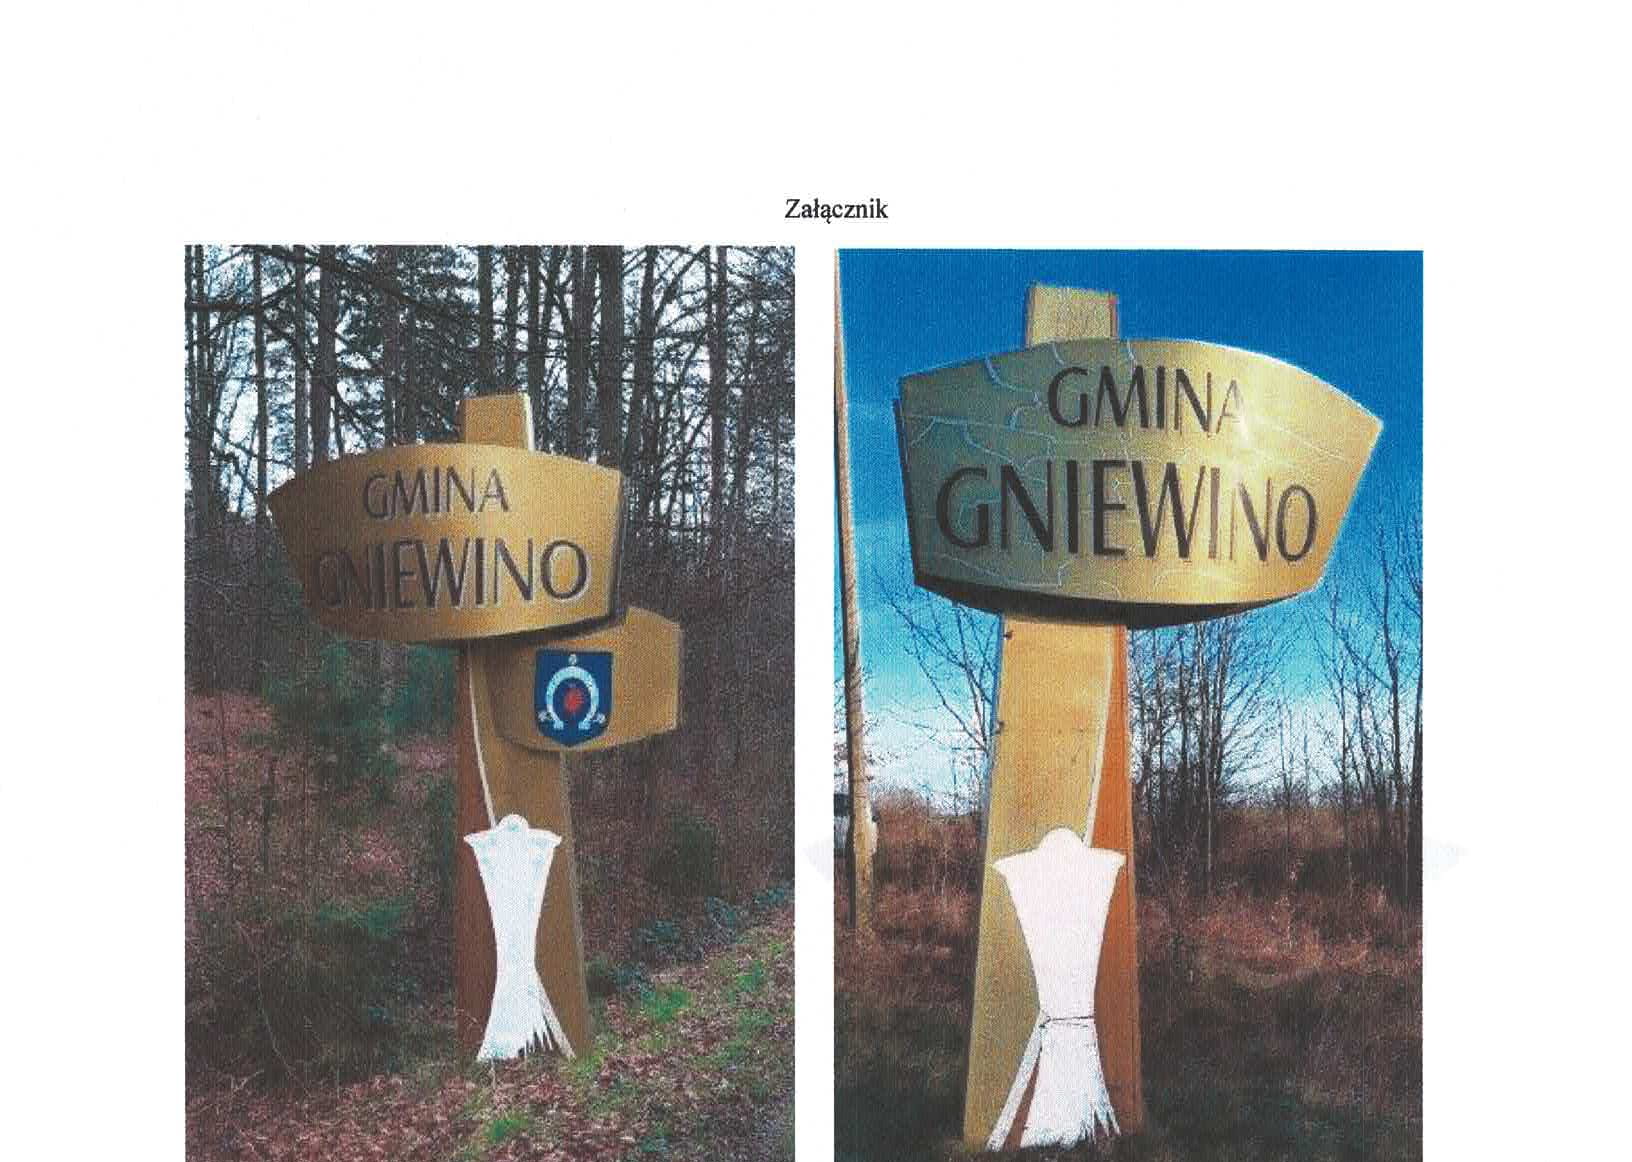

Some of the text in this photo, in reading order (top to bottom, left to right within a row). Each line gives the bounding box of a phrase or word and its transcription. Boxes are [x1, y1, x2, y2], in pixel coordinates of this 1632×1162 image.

[785, 197, 889, 224] Załącznik
[1047, 364, 1247, 437] GMINA
[363, 464, 510, 520] GMINA
[935, 458, 1318, 563] GNIEWINO
[314, 535, 591, 610] GNIEWINO
